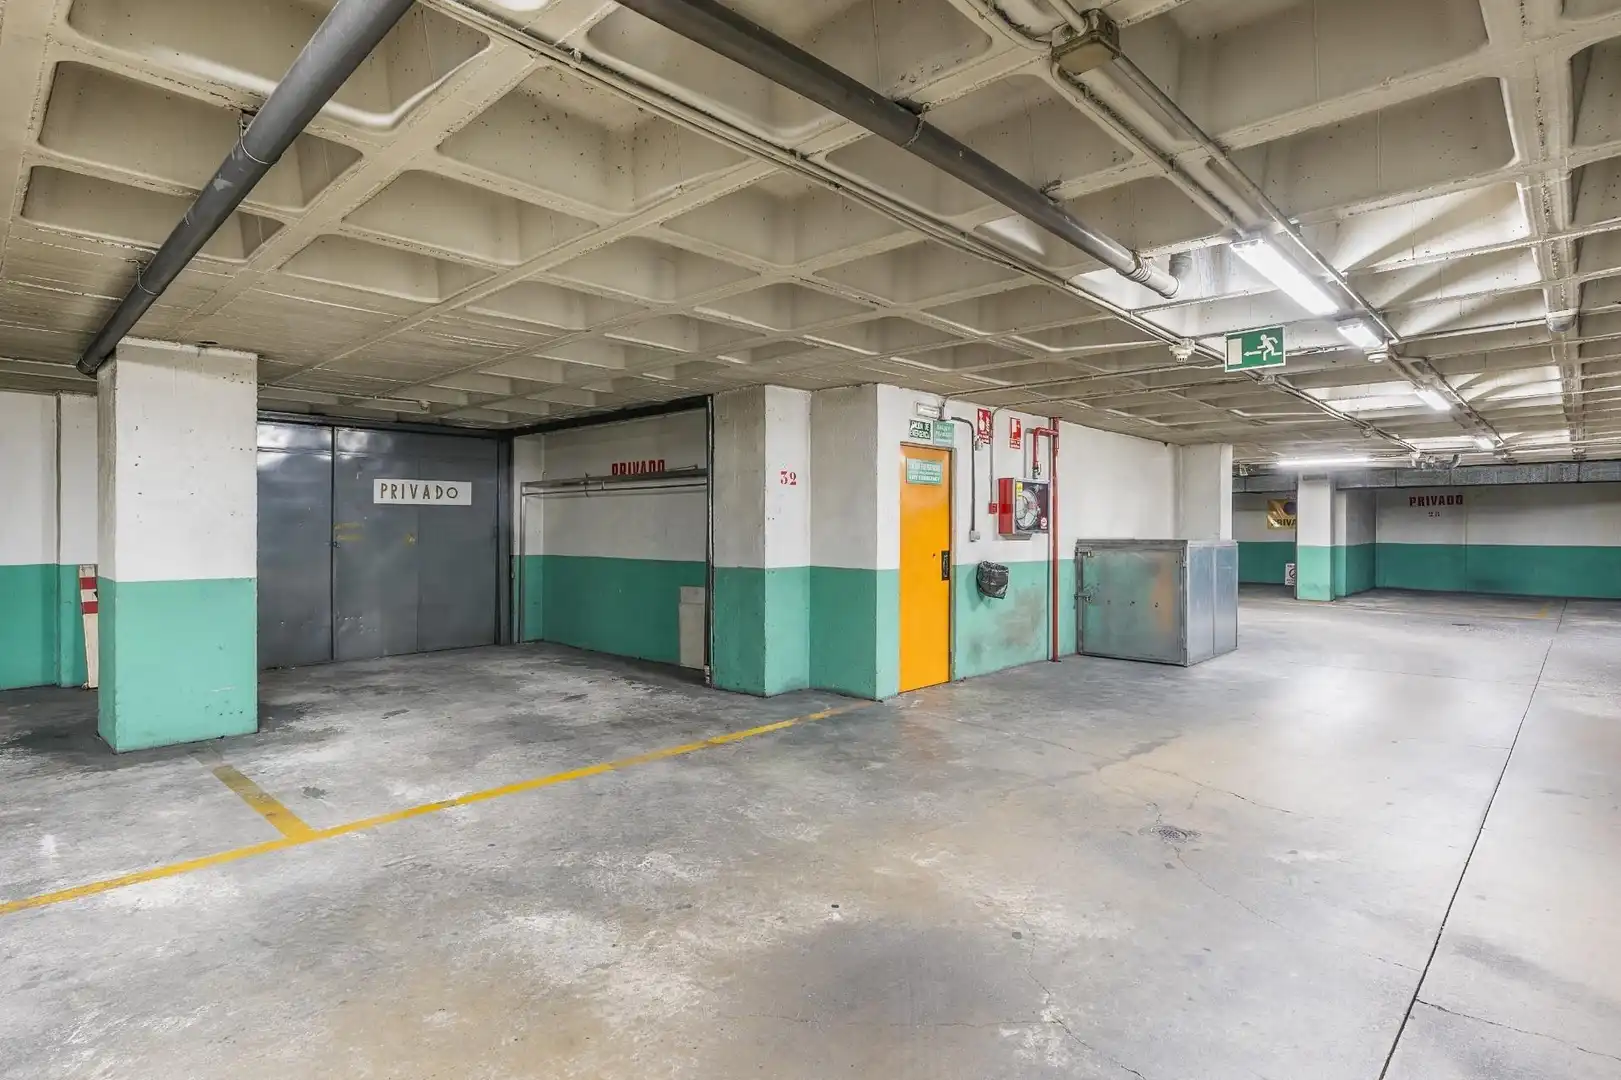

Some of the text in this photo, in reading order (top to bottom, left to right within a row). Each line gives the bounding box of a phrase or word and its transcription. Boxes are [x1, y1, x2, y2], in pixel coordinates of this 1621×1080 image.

[612, 459, 665, 476] PRIVADO
[780, 470, 797, 486] 32
[380, 483, 458, 500] PRIVADO
[1409, 494, 1464, 507] PRIVADO
